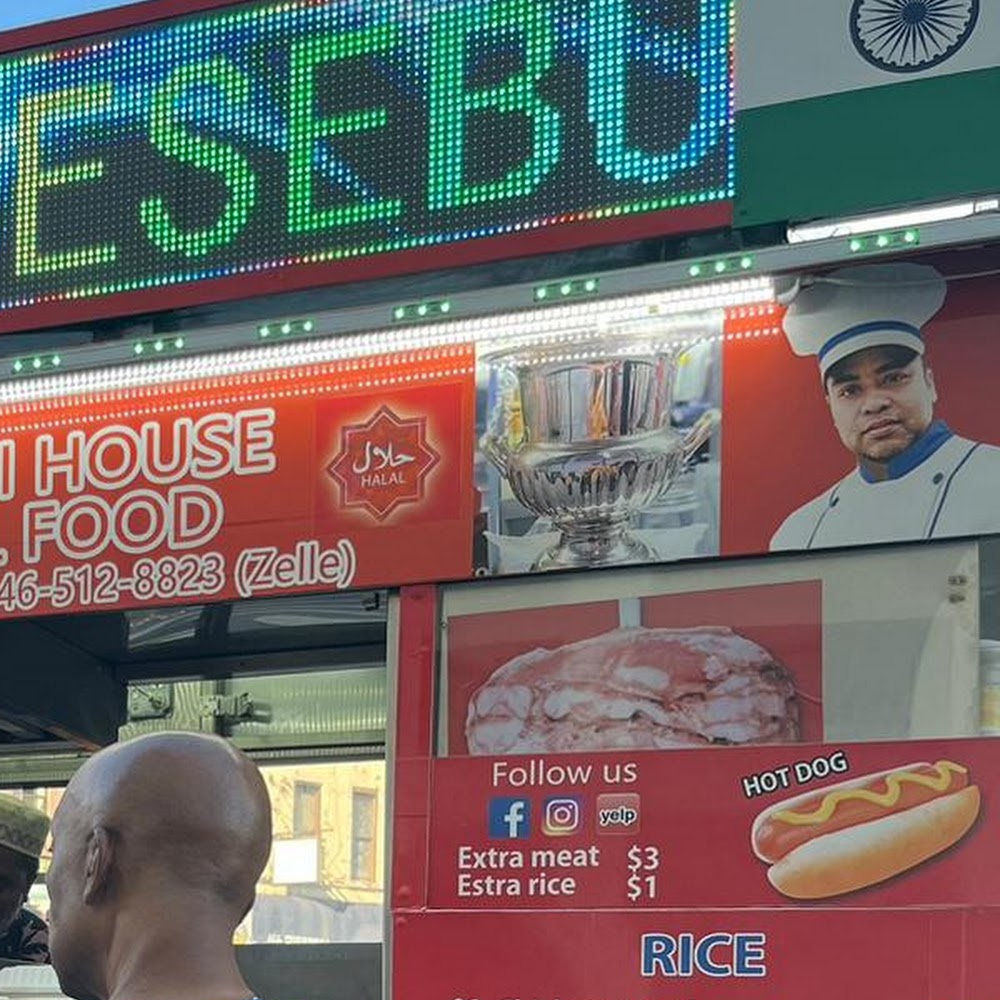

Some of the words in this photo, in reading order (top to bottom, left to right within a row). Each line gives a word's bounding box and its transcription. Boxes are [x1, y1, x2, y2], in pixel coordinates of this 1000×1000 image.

[35, 407, 277, 495] HOUSE
[352, 441, 415, 474] حلال
[361, 472, 406, 488] HALAL
[23, 485, 224, 563] FOOD
[234, 538, 356, 596] (Zelle)
[493, 760, 592, 787] Follow
[604, 762, 638, 783] us
[743, 768, 790, 797] HOT
[796, 752, 848, 785] DOG
[600, 807, 636, 826] yelp
[458, 847, 524, 869] Extra
[531, 845, 600, 868] meat
[627, 845, 659, 872] $3
[458, 873, 521, 897] Estra
[528, 874, 577, 895] rice
[627, 873, 656, 900] $1
[640, 933, 766, 977] RICE
